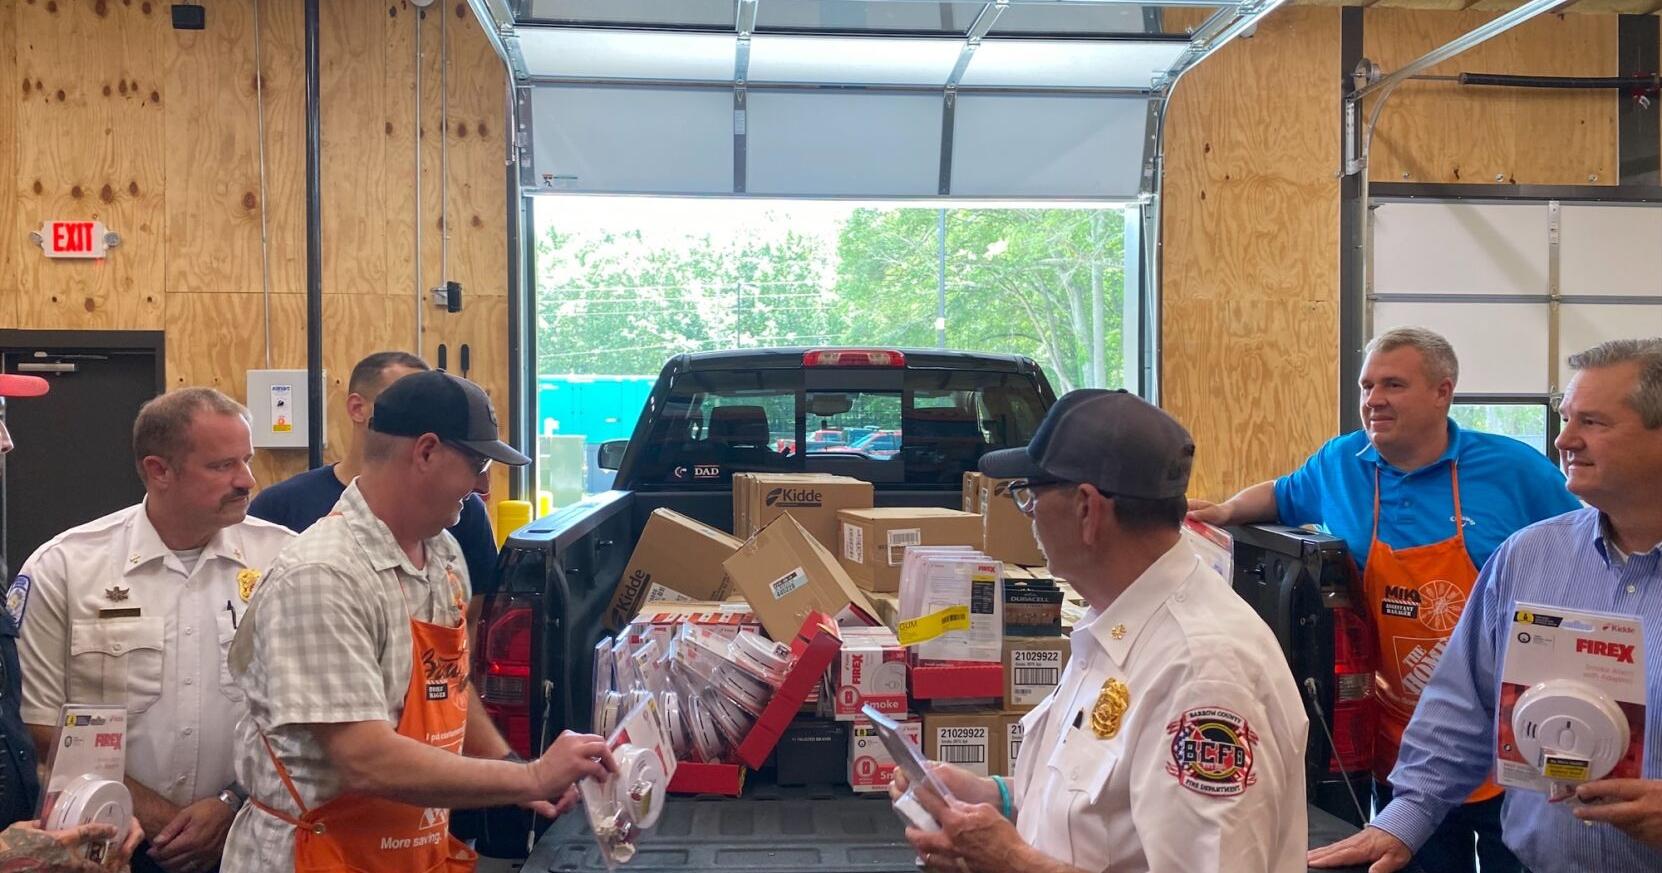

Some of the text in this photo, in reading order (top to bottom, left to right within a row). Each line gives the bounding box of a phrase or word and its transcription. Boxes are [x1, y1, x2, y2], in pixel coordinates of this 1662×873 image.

[53, 223, 93, 251] EXIT
[695, 467, 719, 475] DAD
[782, 488, 822, 502] Kidde
[620, 569, 645, 611] Kidde
[1015, 652, 1058, 661] 21029922
[1402, 644, 1427, 668] THE
[1576, 638, 1635, 664] FIREX
[852, 654, 863, 685] FIREX
[941, 729, 985, 738] 21029922
[95, 733, 122, 750] FIREX
[1185, 779, 1199, 789] FIRE
[381, 836, 411, 850] More
